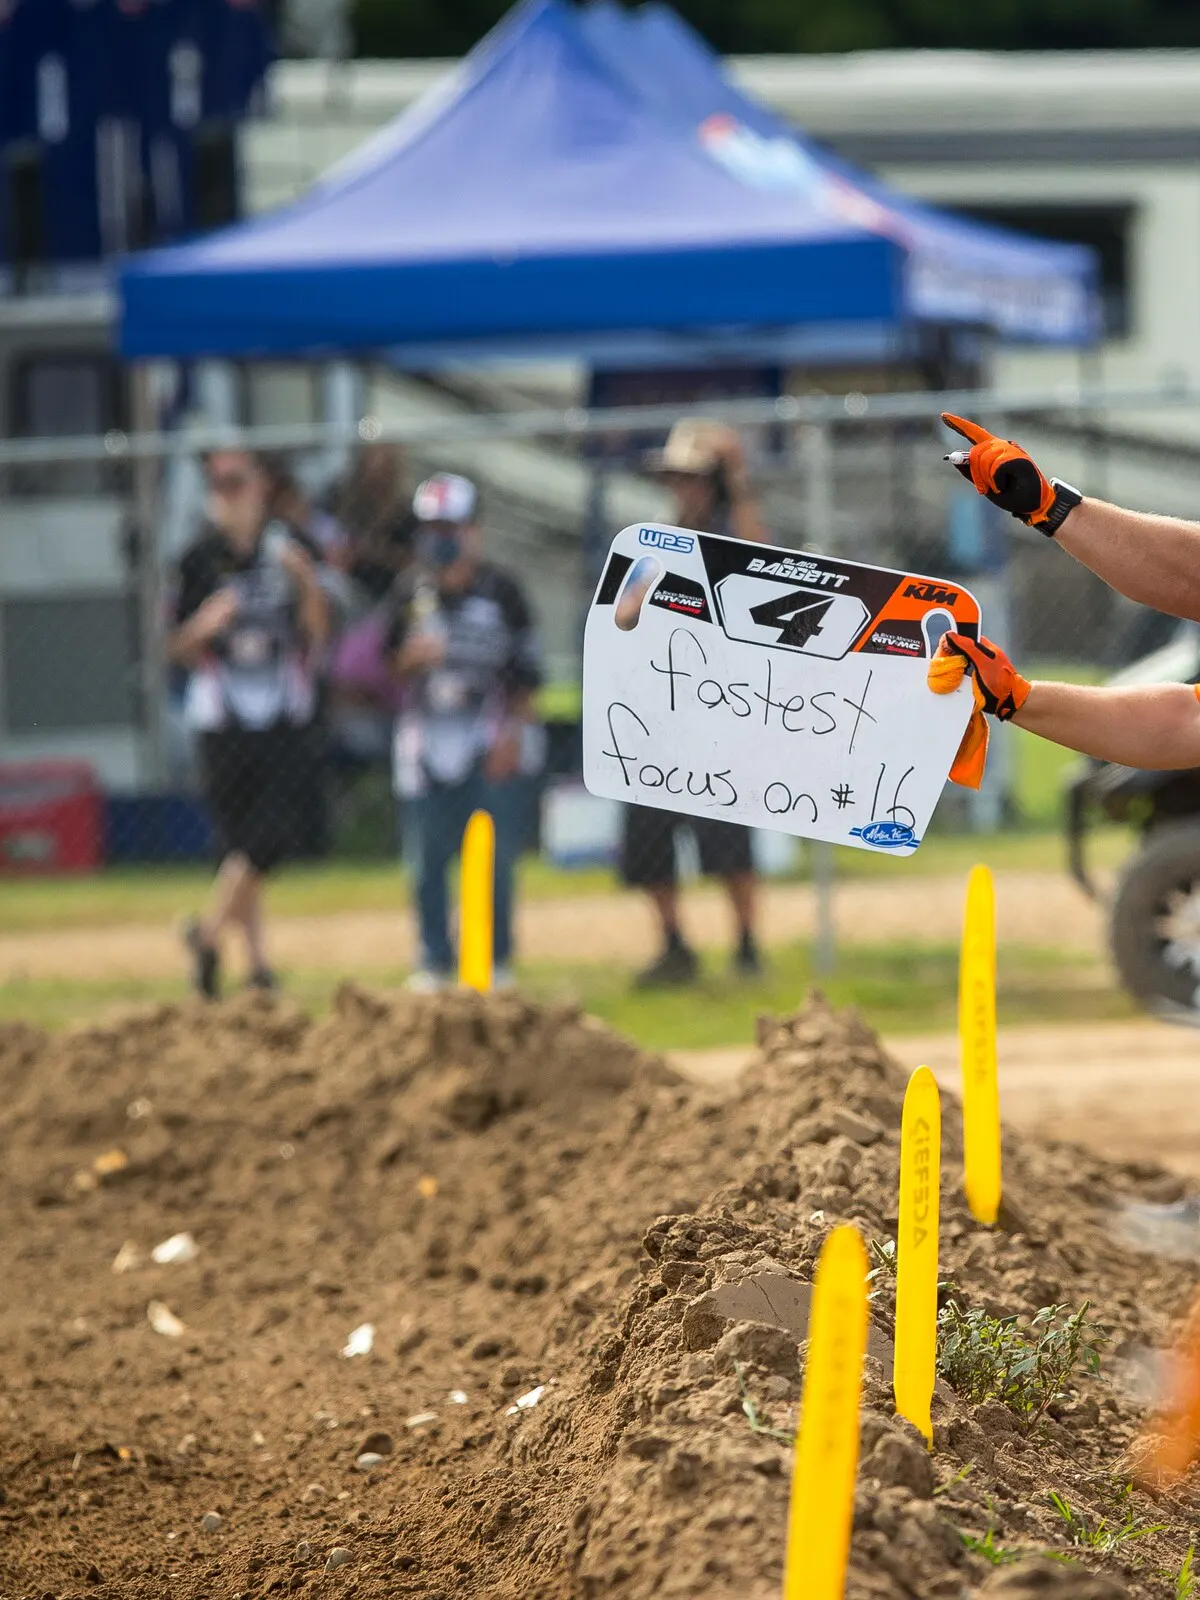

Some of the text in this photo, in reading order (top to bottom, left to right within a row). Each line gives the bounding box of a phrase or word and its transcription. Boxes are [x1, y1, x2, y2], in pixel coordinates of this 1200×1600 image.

[639, 528, 694, 554] WPS
[746, 558, 850, 588] BAGGETT
[782, 558, 818, 569] BLAKE
[902, 582, 958, 606] KTM
[749, 590, 835, 648] 4
[650, 628, 877, 754] fastest
[602, 702, 916, 833] focus on #16
